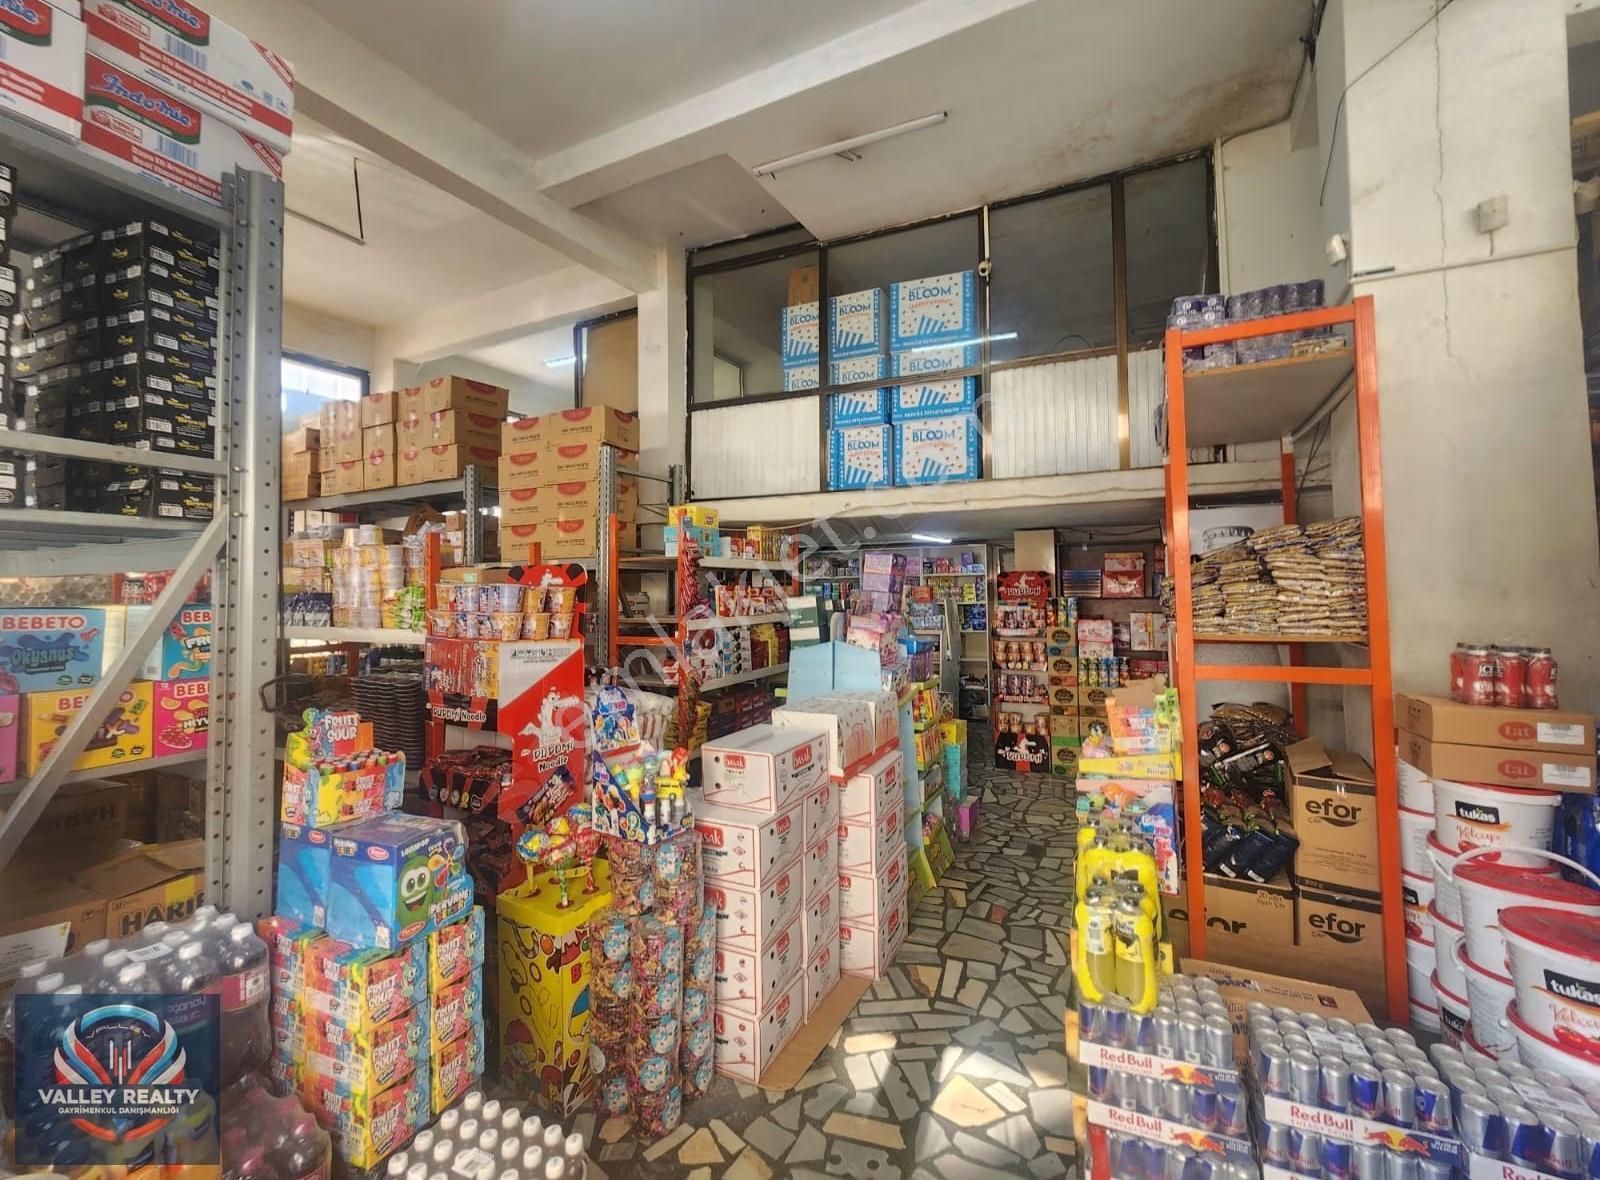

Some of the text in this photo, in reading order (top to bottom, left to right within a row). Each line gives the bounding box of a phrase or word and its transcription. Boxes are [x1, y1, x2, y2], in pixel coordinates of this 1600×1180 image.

[908, 286, 952, 301] BLOOM
[839, 303, 871, 316] BLOOM
[909, 358, 952, 372] BLOOM
[843, 372, 874, 382] BLOOM
[913, 430, 955, 442] BLOOM
[848, 440, 879, 451] BLOOM
[2, 615, 85, 630] BEBETO
[183, 611, 211, 623] BEB
[10, 647, 75, 668] Okyanus
[176, 683, 209, 697] BEB
[58, 691, 134, 711] BEO
[324, 714, 359, 731] FRUIT
[327, 727, 357, 742] SOUR
[1505, 726, 1529, 736] tat
[539, 756, 567, 771] Noodle
[1505, 765, 1529, 775] tat
[1306, 798, 1361, 820] efor
[122, 892, 205, 936] HARI
[1309, 913, 1365, 936] efor
[367, 975, 396, 997] FRUIT
[1100, 1048, 1152, 1069] Red Bull
[1109, 1109, 1162, 1132] Red Bull
[1290, 1105, 1354, 1132] Red Bull
